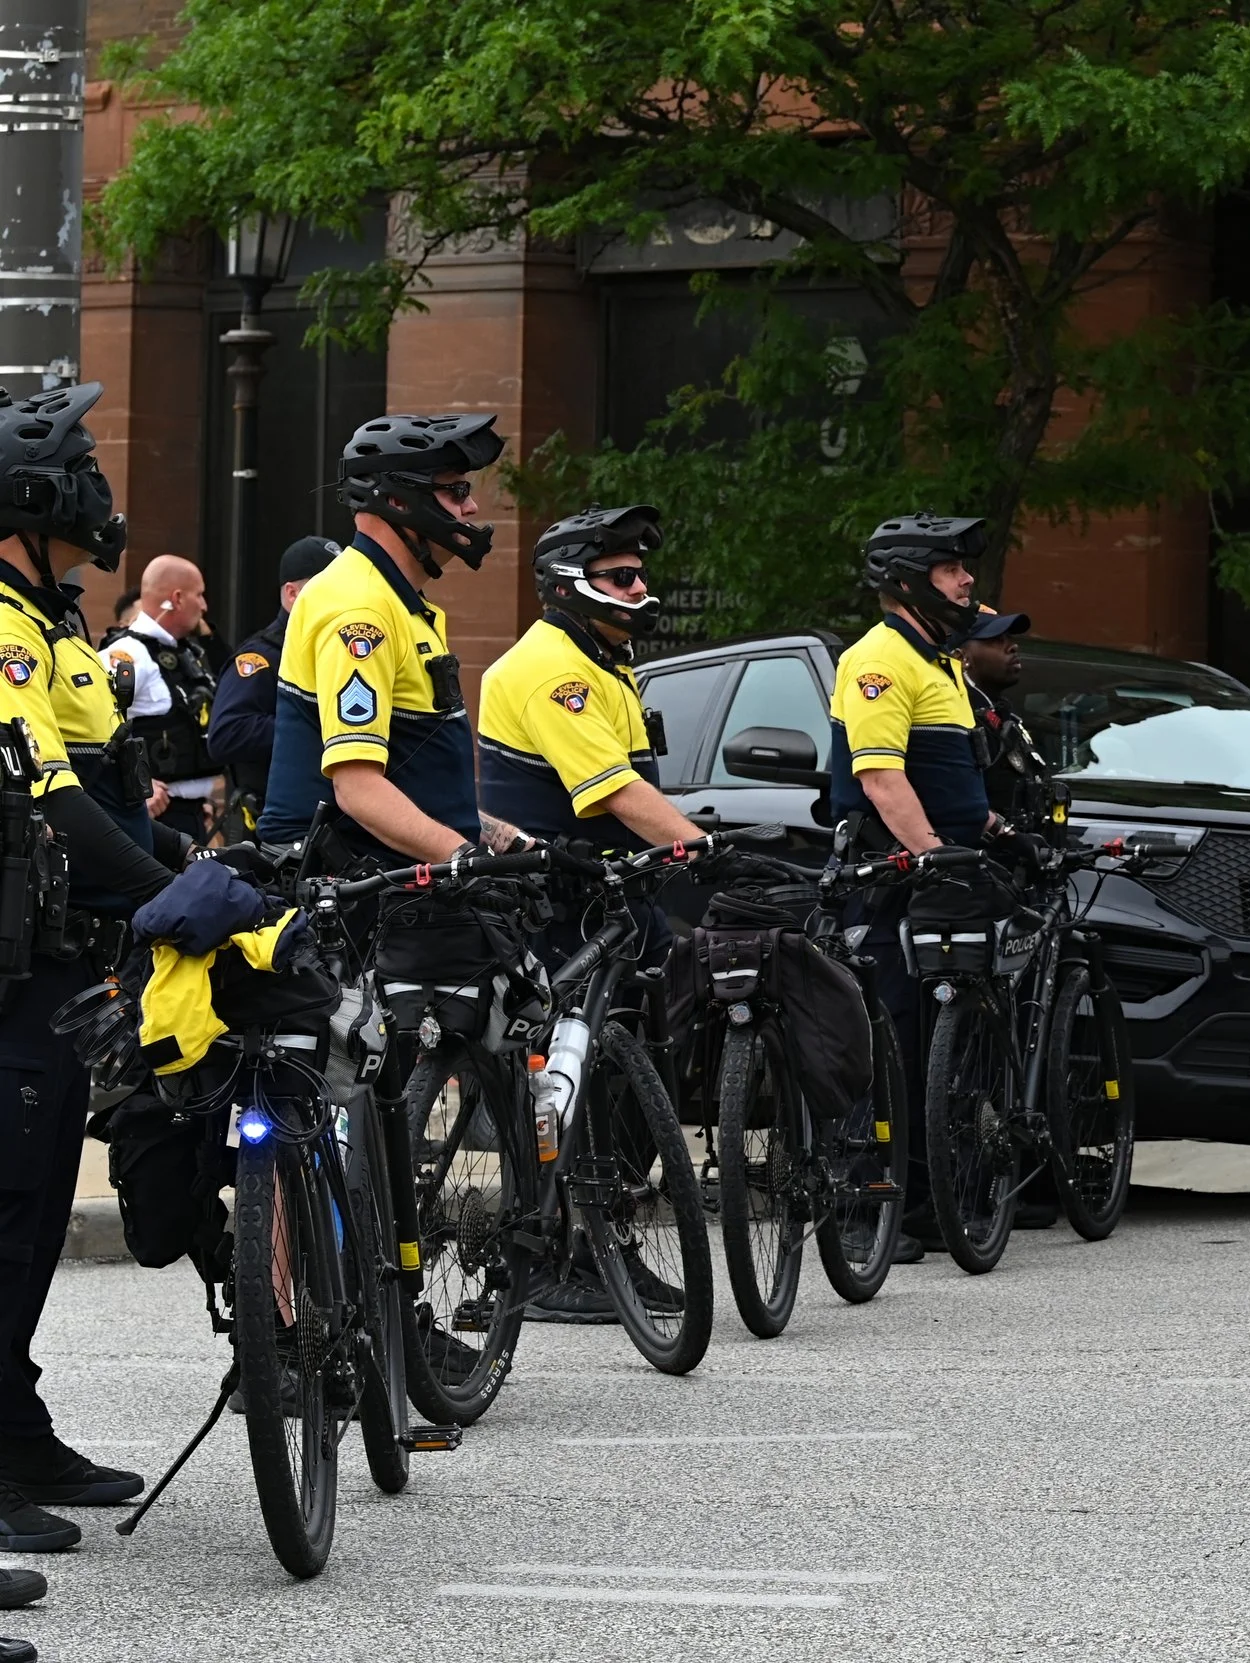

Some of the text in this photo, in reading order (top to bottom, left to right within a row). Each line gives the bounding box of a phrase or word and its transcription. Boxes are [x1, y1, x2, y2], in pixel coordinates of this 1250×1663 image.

[340, 623, 383, 638] CLEVELAND
[346, 630, 377, 640] POLICE
[0, 652, 30, 662] POLICE
[551, 682, 588, 699] CLEVELAND
[558, 687, 584, 699] POLICE
[1004, 935, 1035, 956] POLICE
[480, 1349, 510, 1400] SERFAS
